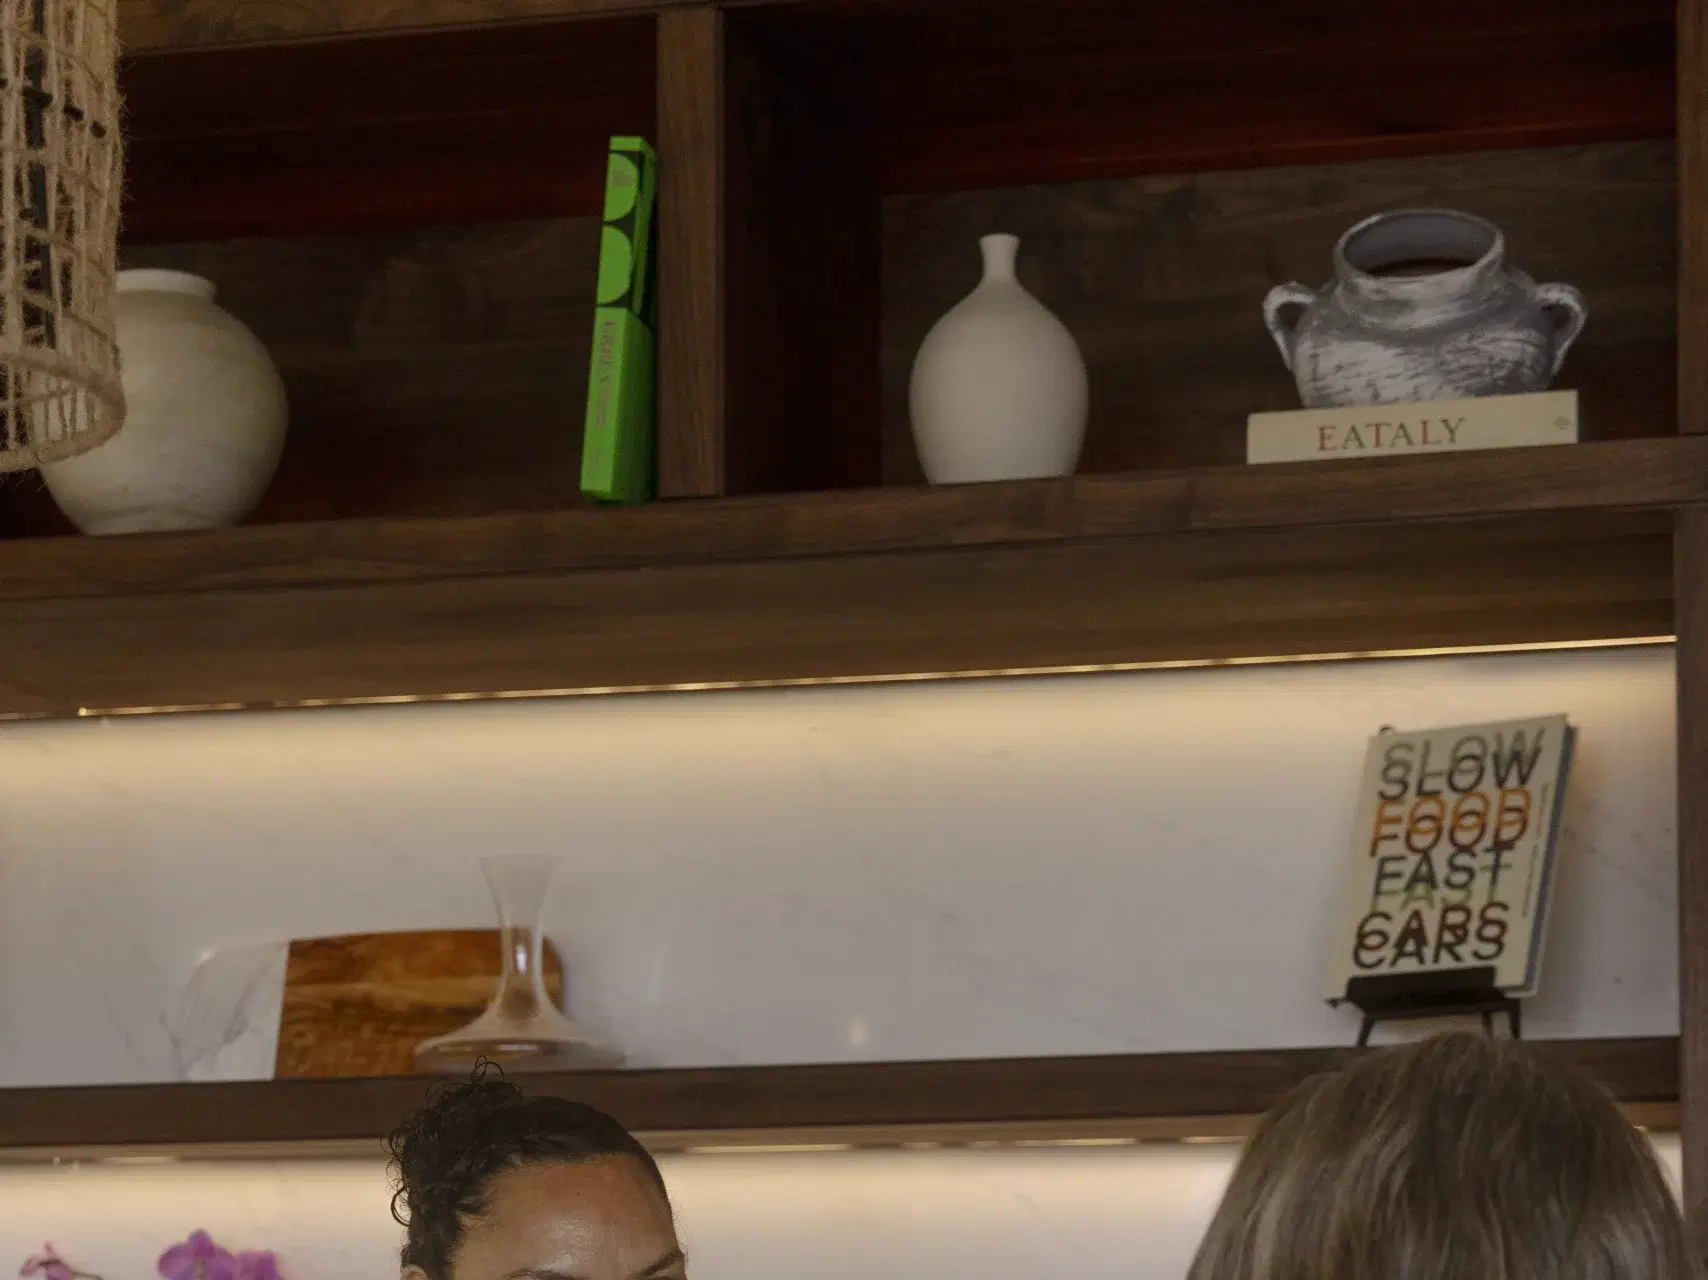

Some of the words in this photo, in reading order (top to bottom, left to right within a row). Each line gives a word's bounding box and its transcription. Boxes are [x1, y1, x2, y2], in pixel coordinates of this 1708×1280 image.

[1317, 416, 1467, 452] EATALY
[1377, 726, 1546, 804] SLOW
[1370, 787, 1532, 858] FOOD
[1369, 842, 1518, 911] FAST
[1352, 902, 1510, 969] CARS
